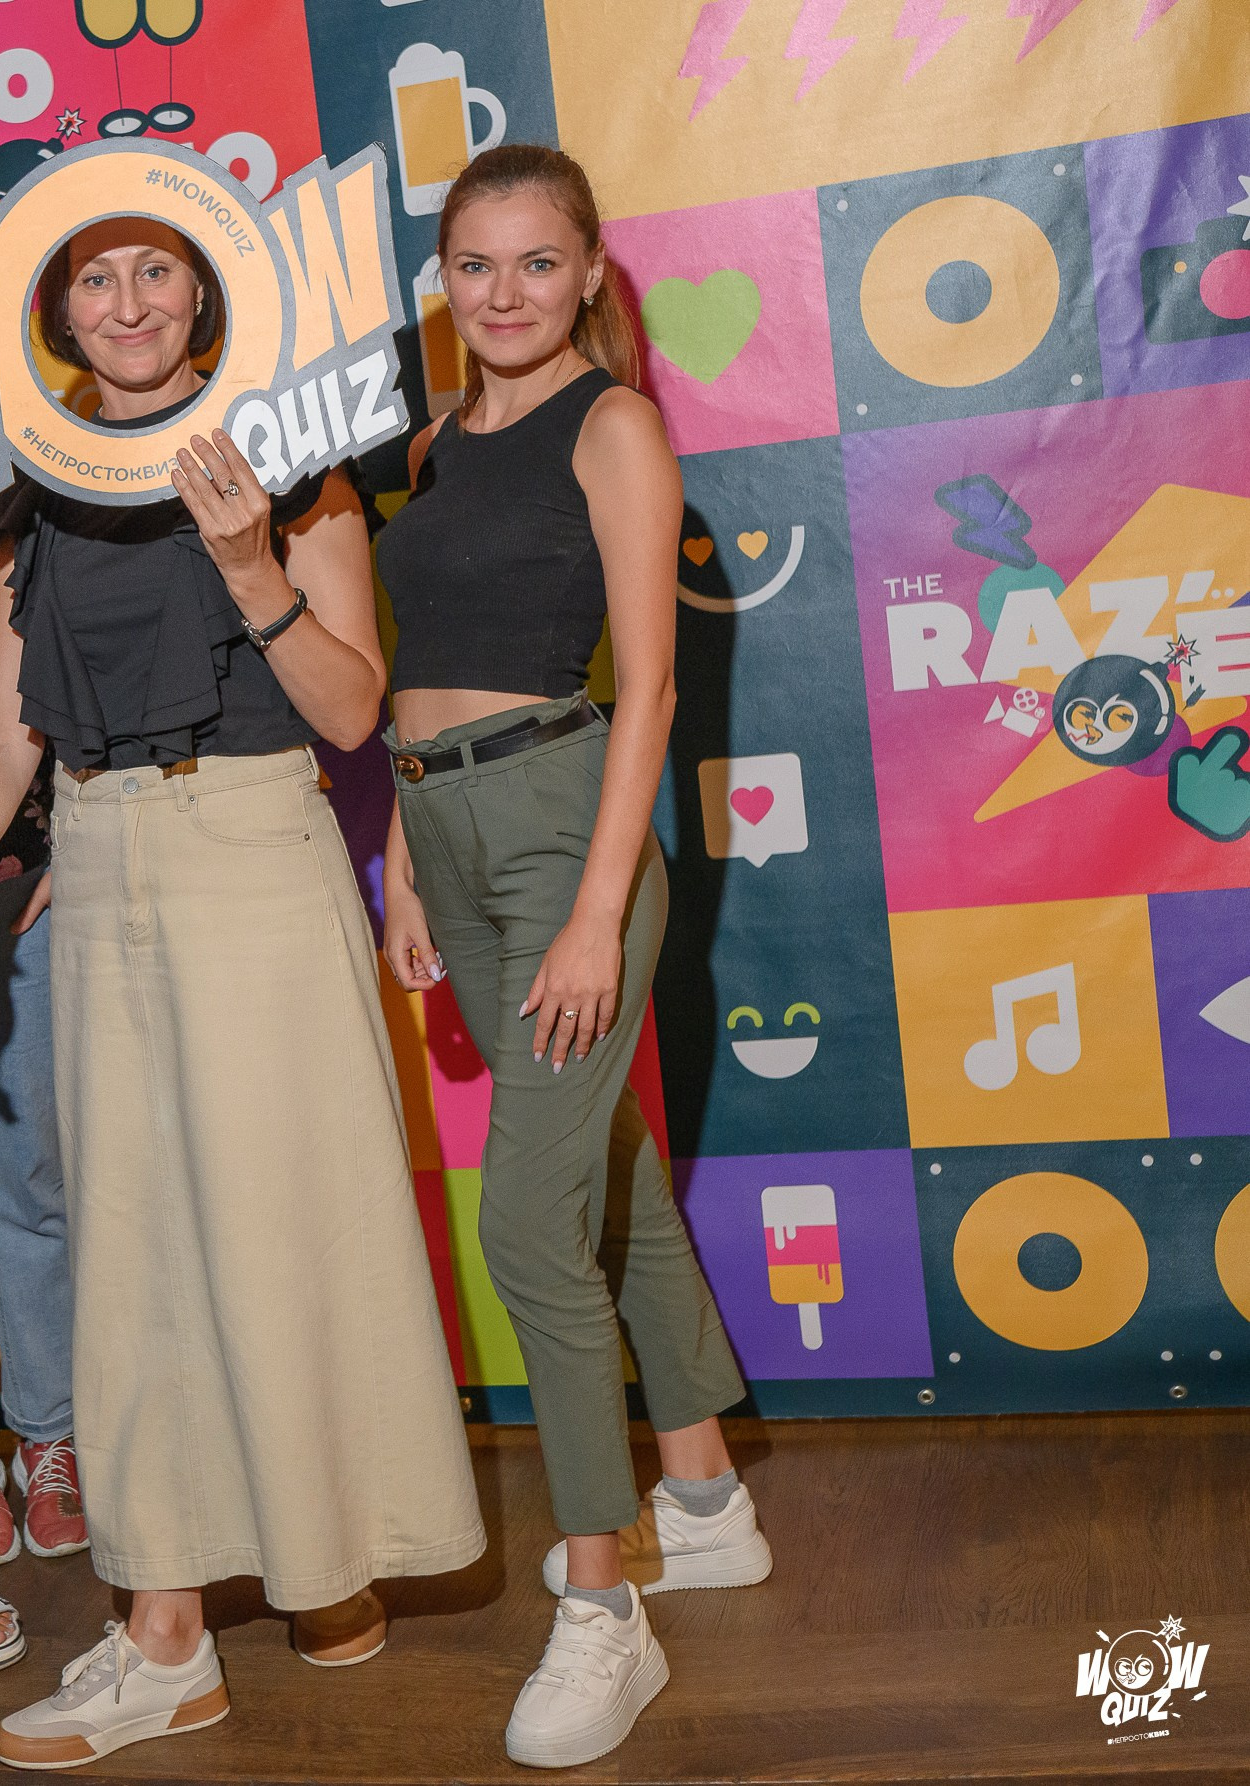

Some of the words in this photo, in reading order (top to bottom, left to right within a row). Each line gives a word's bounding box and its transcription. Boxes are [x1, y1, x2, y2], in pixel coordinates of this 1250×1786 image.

[145, 168, 256, 258] #WOWQUIZ
[21, 426, 180, 482] #НЕПРОСТОКВИЗ
[230, 350, 400, 485] QUIZ
[883, 573, 944, 599] THE
